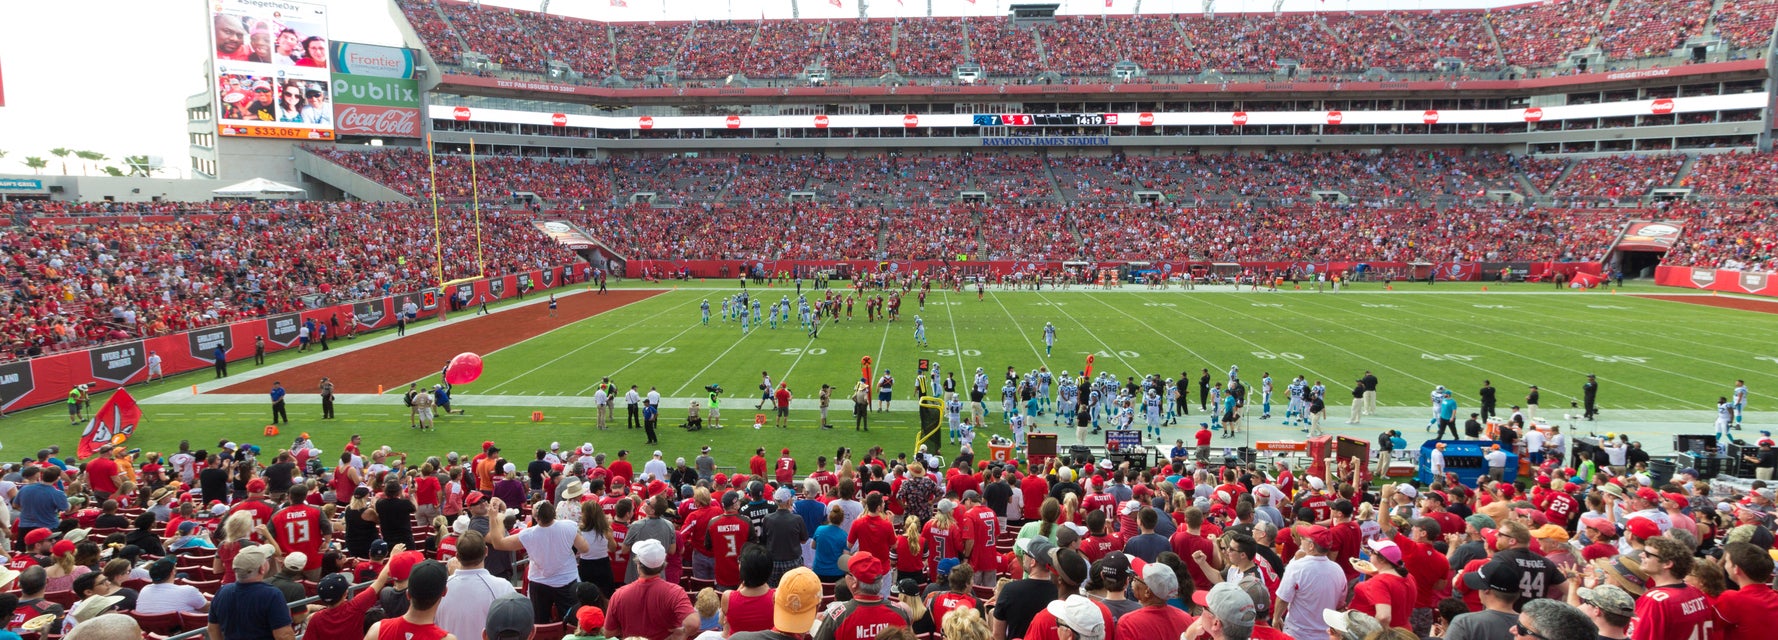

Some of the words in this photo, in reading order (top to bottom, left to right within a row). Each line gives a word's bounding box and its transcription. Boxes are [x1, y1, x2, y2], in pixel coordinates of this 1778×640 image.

[350, 53, 400, 67] Frontier
[333, 79, 414, 102] Publix
[497, 80, 513, 88] TEXT
[527, 83, 549, 91] ISSUES
[337, 107, 417, 134] Coca-Cola
[990, 116, 998, 125] 7
[1021, 116, 1030, 125] 9
[1075, 116, 1102, 125] 14:19
[1106, 115, 1117, 124] 25
[254, 126, 301, 137] $33,067
[982, 137, 1032, 146] RAYMOND
[1033, 137, 1065, 146] JAMES
[1067, 137, 1109, 146] STADIUM
[423, 291, 435, 306] 25
[919, 360, 928, 369] 2
[995, 450, 1005, 461] G
[783, 460, 790, 470] 3
[286, 509, 307, 520] EVANS
[1315, 508, 1324, 520] 3
[1549, 500, 1570, 515] 22
[284, 519, 310, 545] 13
[984, 519, 996, 547] 3
[724, 534, 738, 558] 3
[933, 535, 946, 562] 3
[1518, 571, 1545, 598] 44
